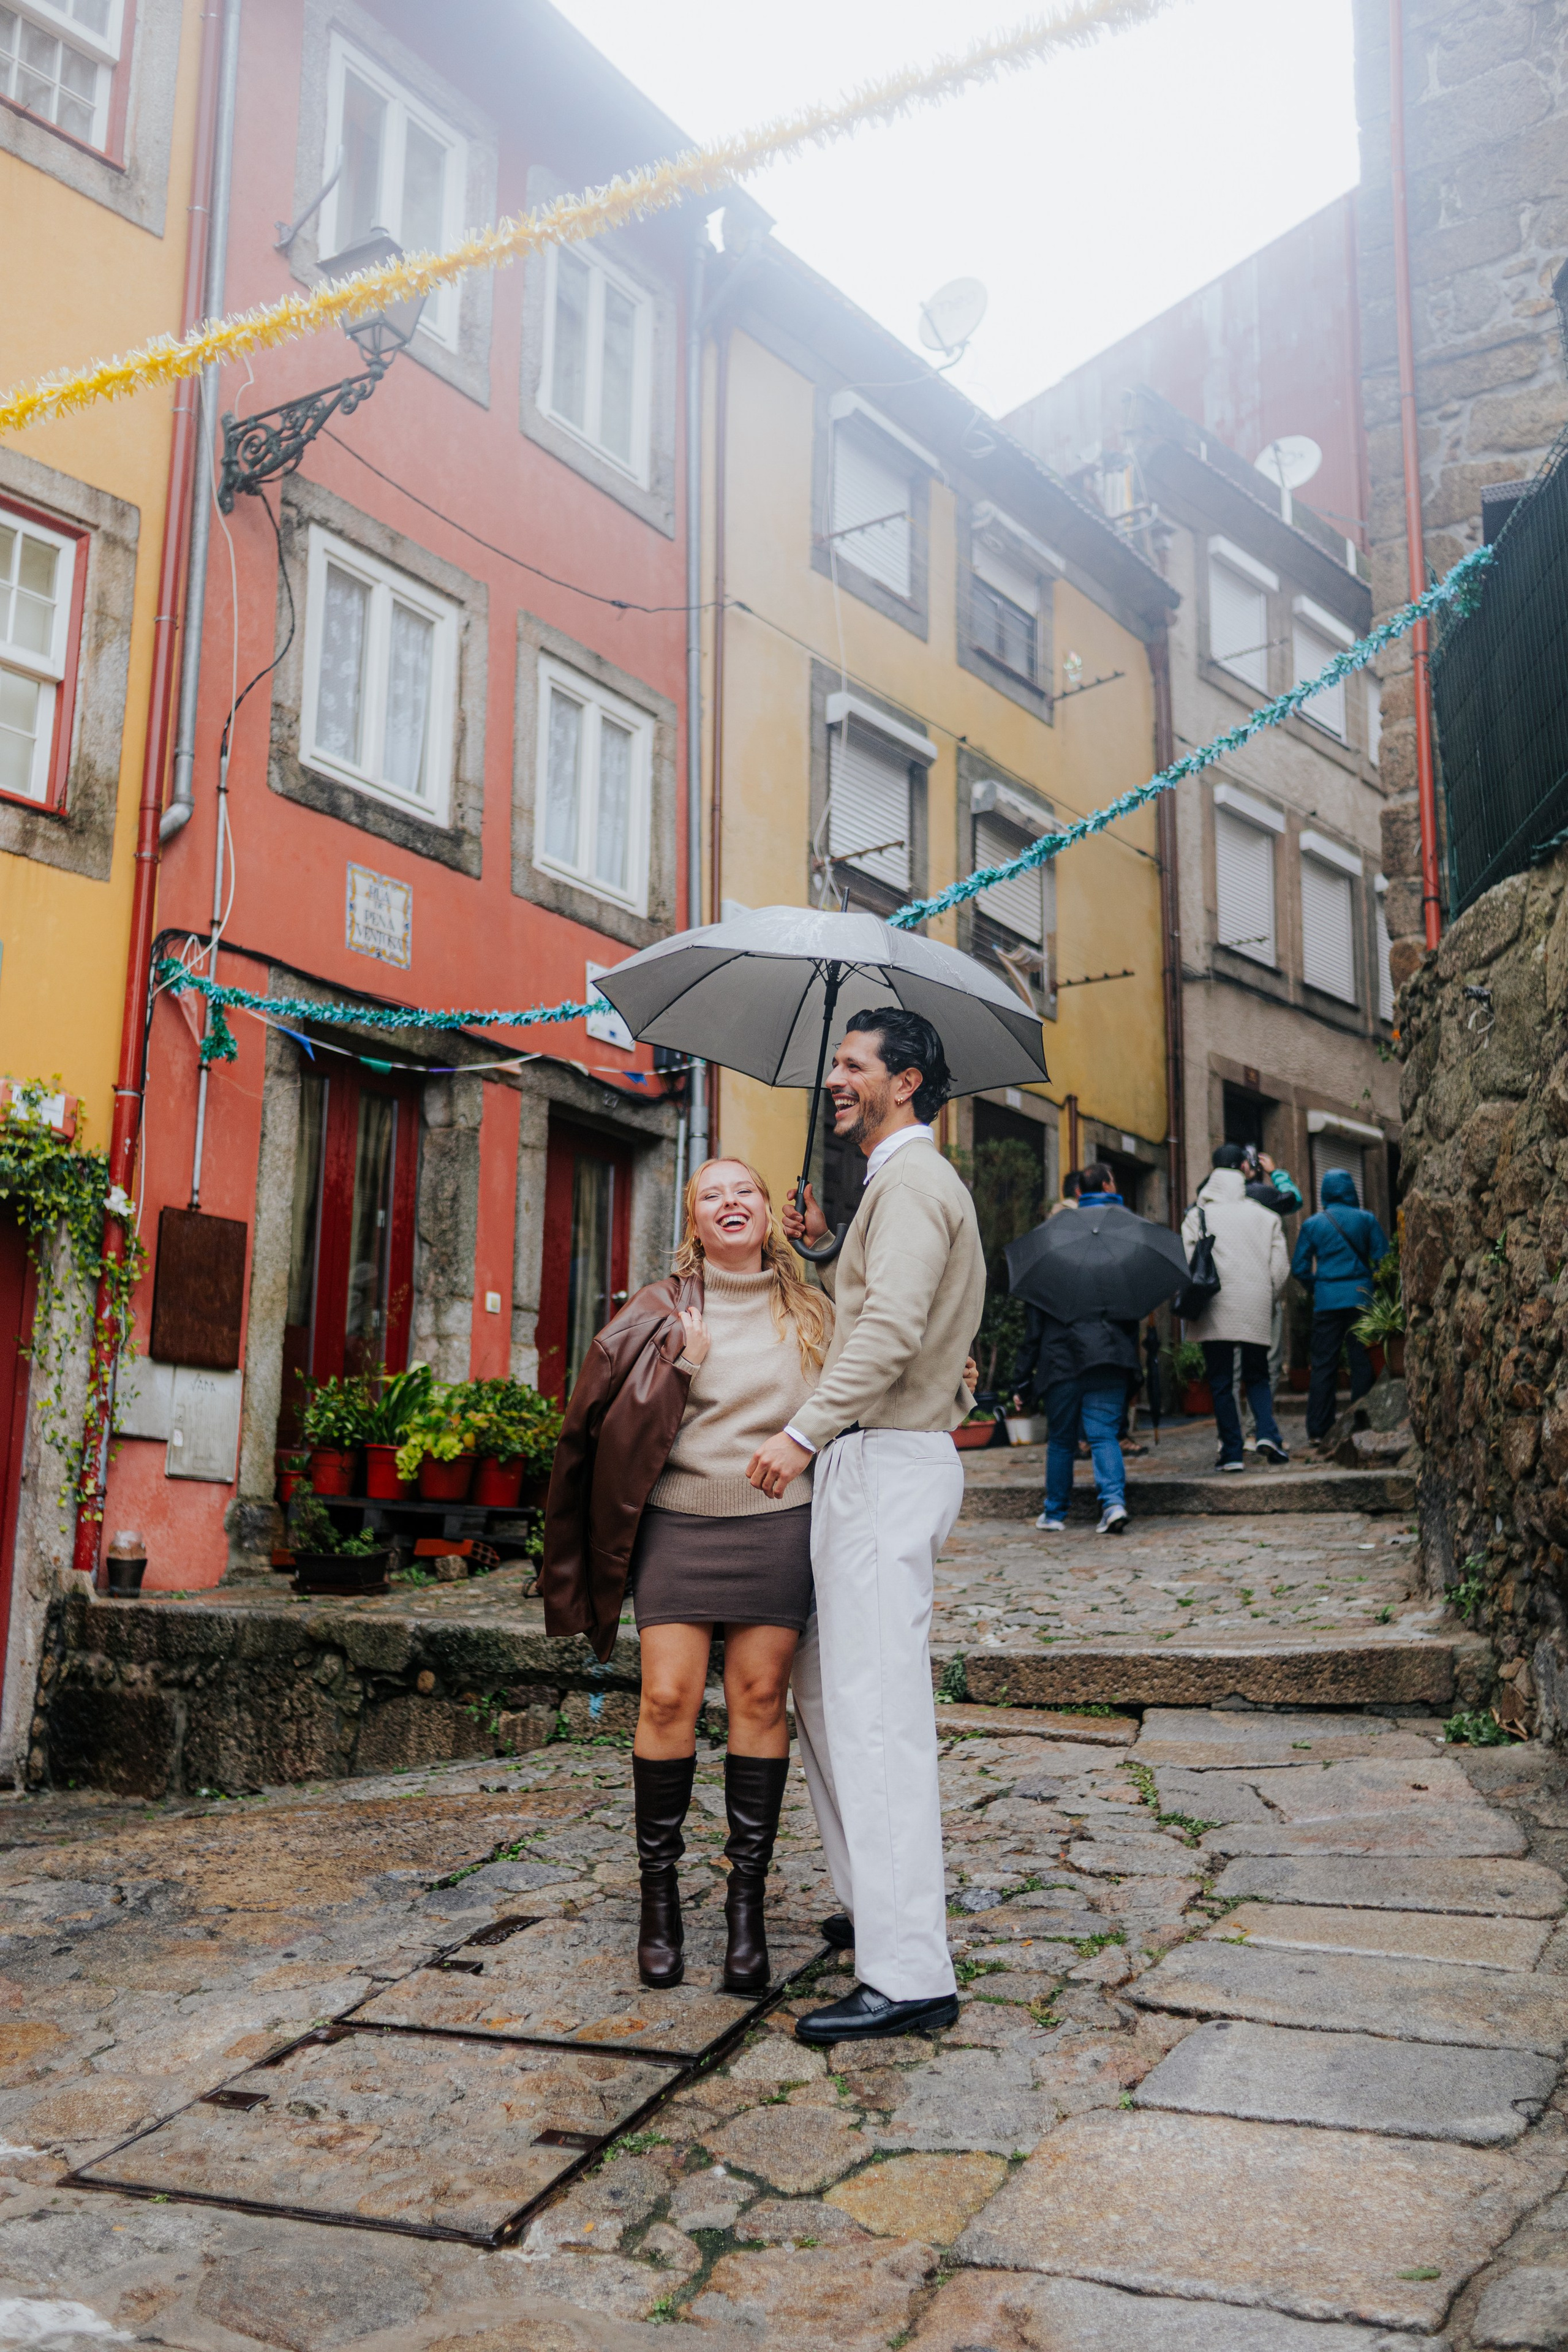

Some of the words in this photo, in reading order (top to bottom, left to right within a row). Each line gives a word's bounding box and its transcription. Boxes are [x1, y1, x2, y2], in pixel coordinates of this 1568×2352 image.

[369, 885, 390, 905] RUA
[365, 910, 395, 932] PENA
[356, 923, 402, 952] VENTOSA
